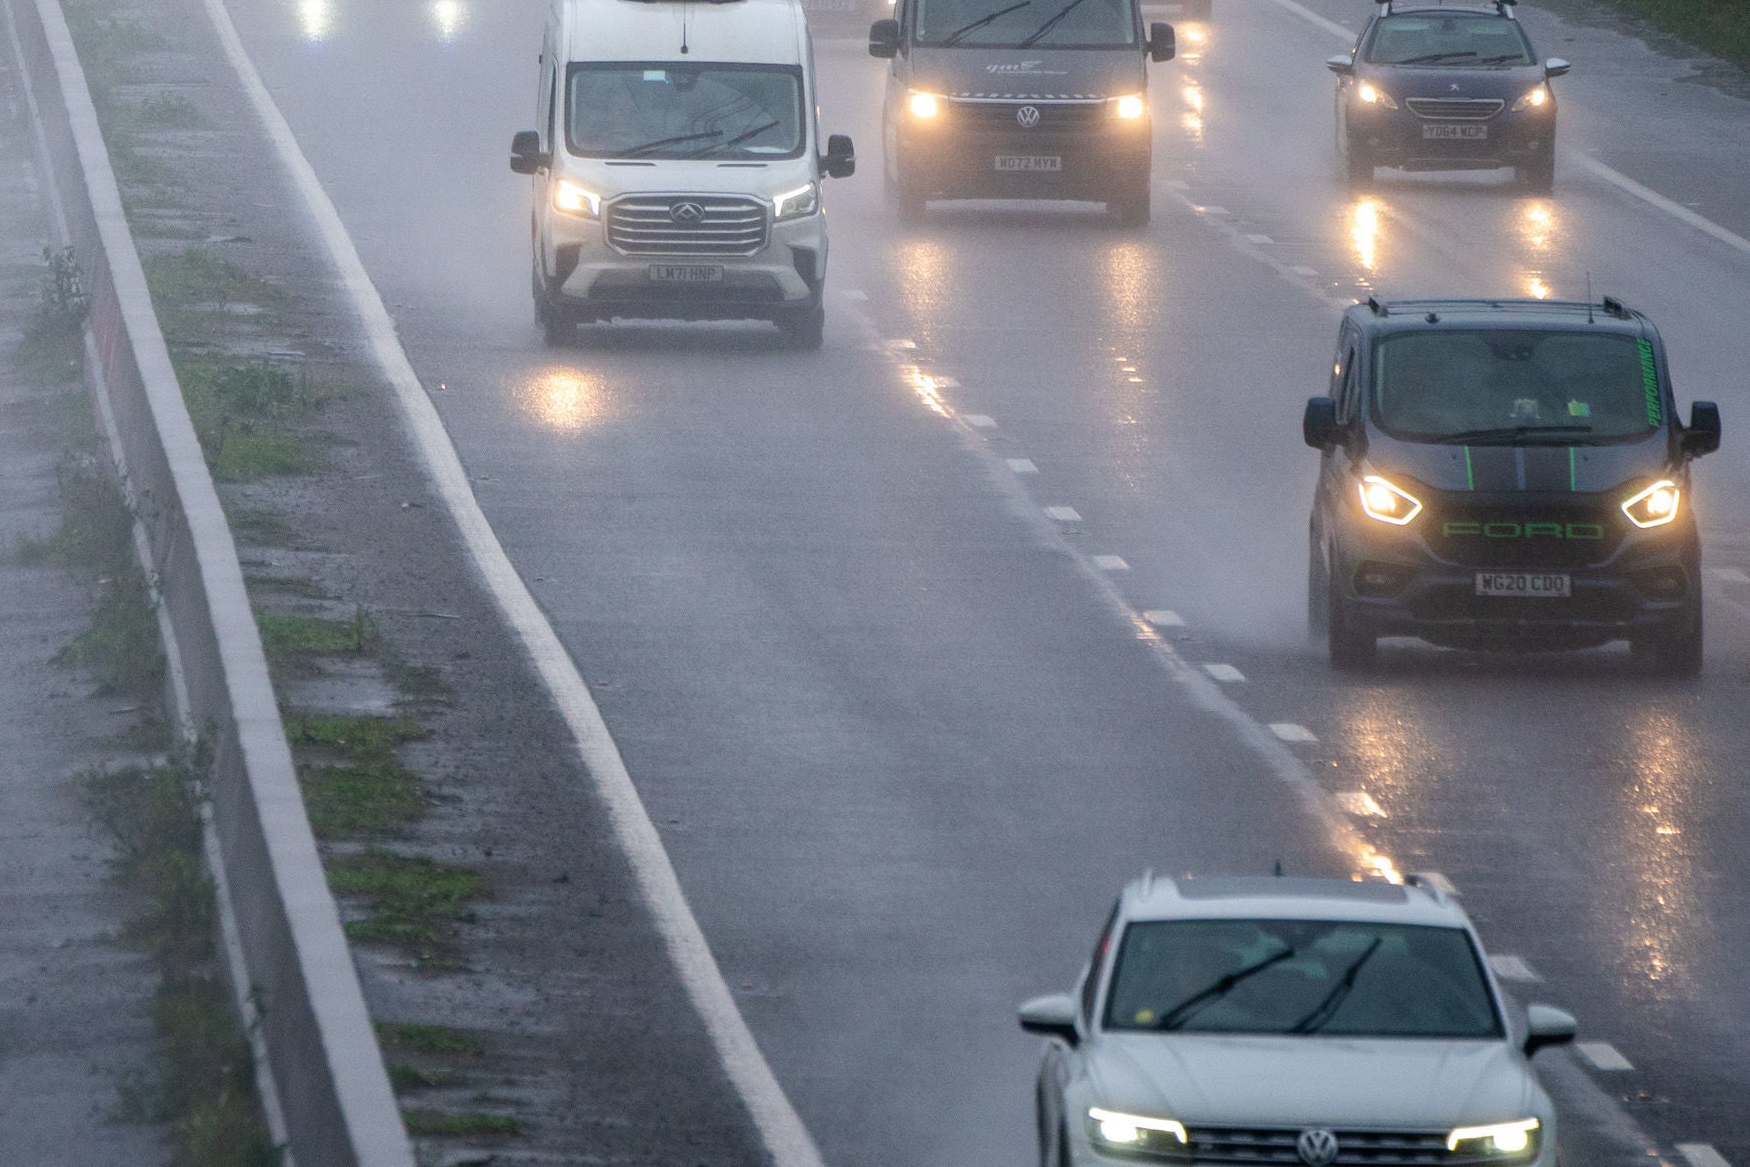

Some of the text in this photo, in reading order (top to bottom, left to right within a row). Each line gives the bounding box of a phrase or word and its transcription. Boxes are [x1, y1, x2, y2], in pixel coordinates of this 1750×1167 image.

[1636, 337, 1662, 427] PERFORMANCE
[1443, 522, 1604, 538] FORD
[1481, 575, 1527, 591] WG20
